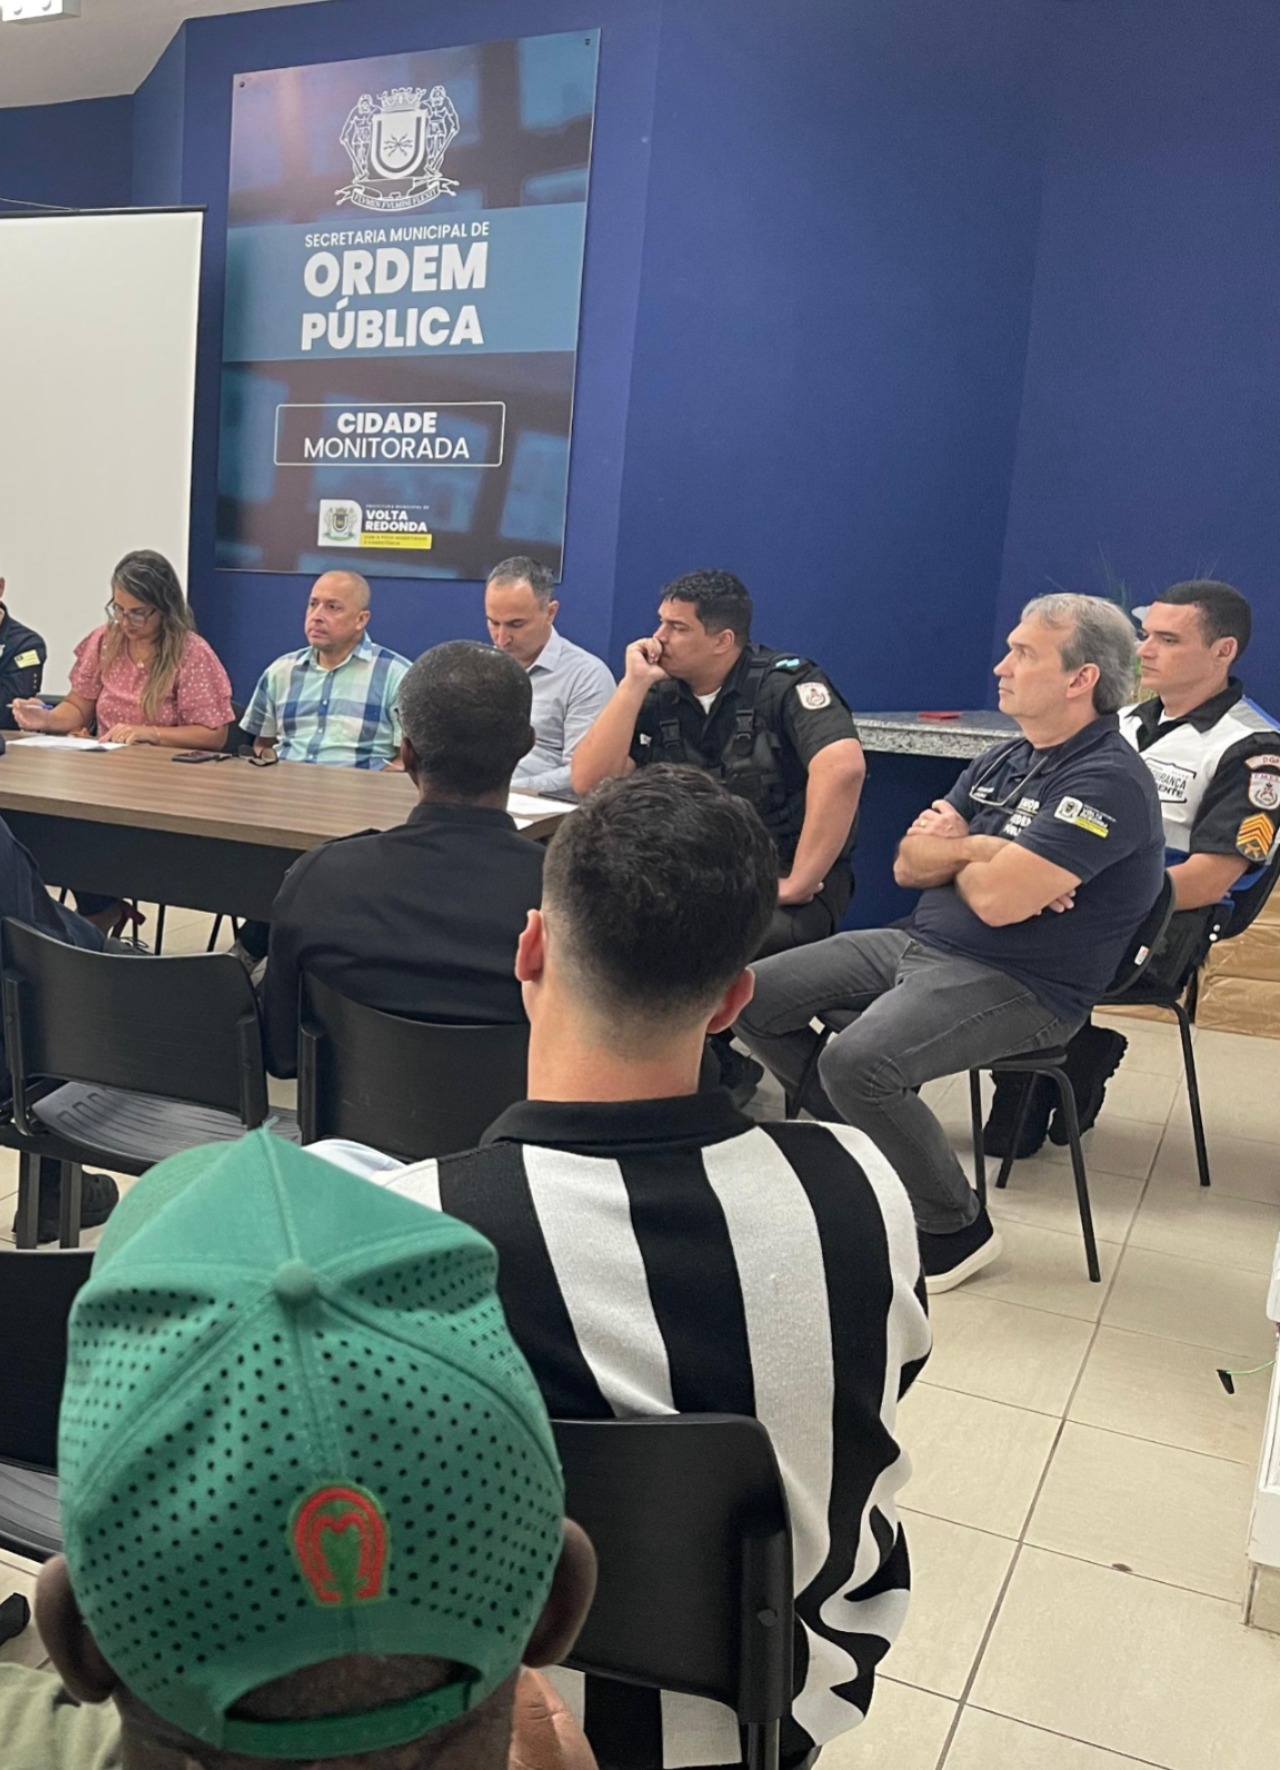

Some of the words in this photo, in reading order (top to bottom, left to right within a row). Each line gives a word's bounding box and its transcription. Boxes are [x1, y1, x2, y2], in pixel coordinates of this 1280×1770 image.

[304, 229, 387, 247] SECRETARIA
[389, 223, 468, 242] MUNICIPAL
[471, 221, 490, 236] DE
[303, 241, 489, 298] ORDEM
[301, 297, 484, 351] PÚBLICA
[337, 411, 438, 434] CIDADE
[303, 436, 470, 460] MONITORADA
[365, 509, 408, 520] VOLTA
[365, 520, 428, 532] REDONDA
